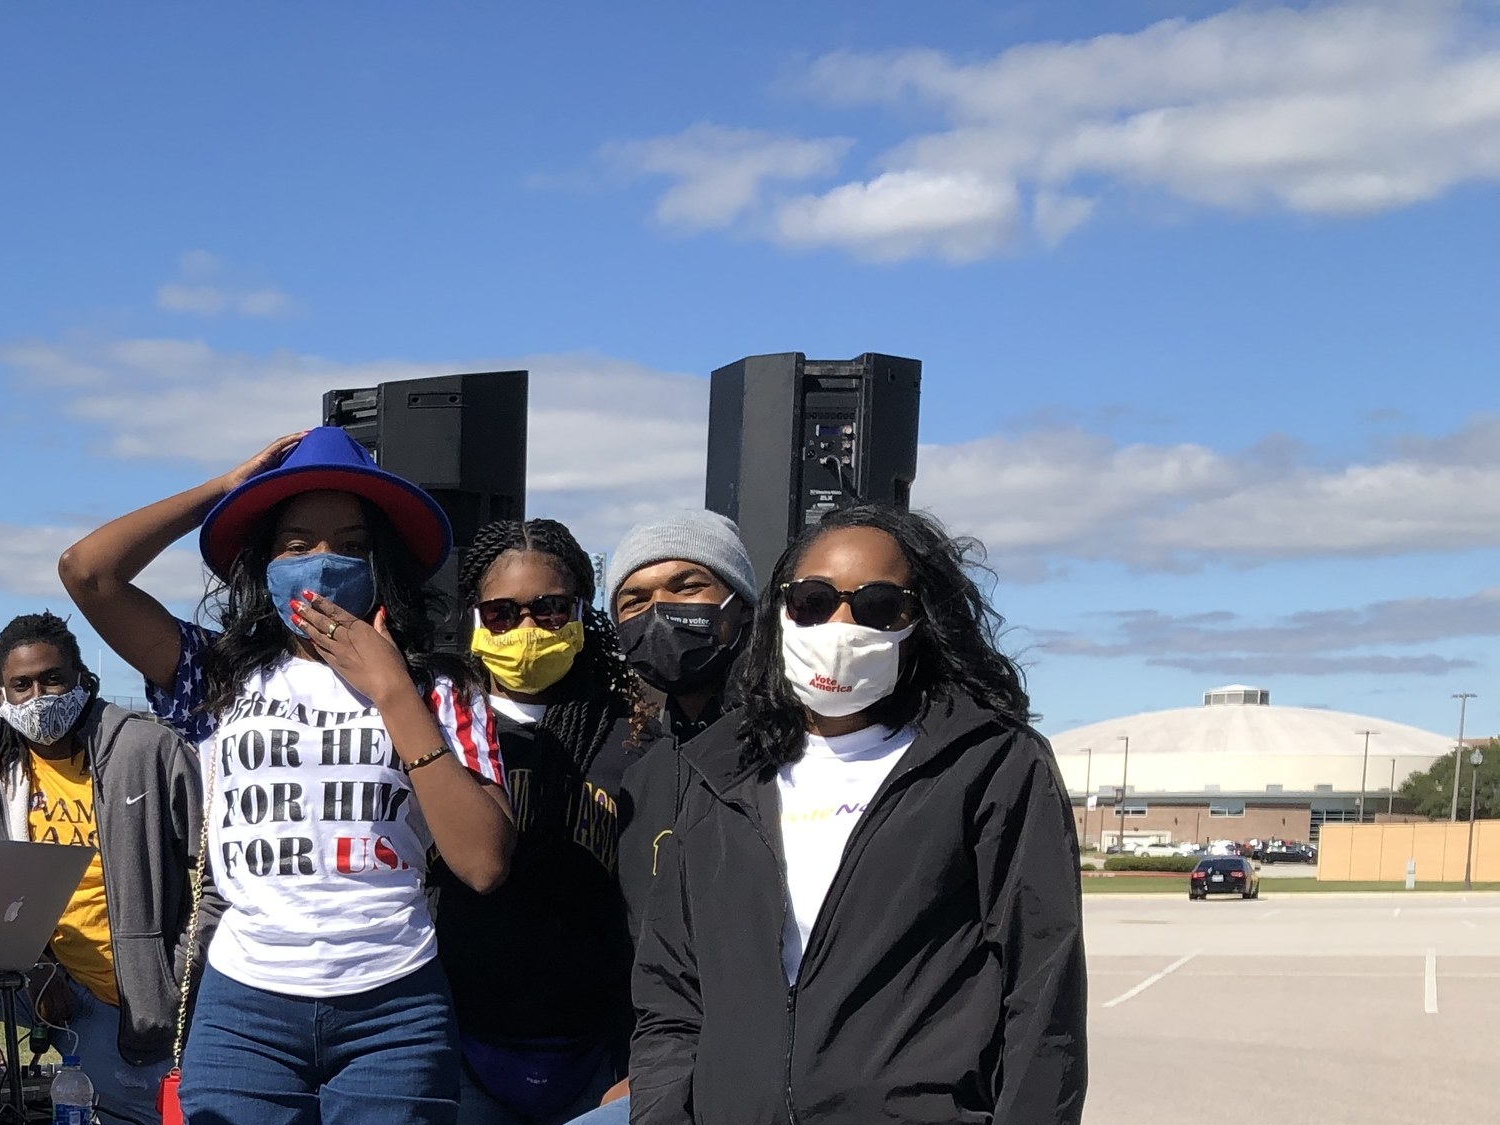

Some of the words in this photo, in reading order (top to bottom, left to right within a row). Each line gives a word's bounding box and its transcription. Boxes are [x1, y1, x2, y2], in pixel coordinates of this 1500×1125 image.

[809, 678, 853, 693] America
[814, 672, 838, 686] Vote
[221, 729, 304, 778] FOR
[221, 782, 306, 829] FOR
[221, 836, 318, 880] FOR
